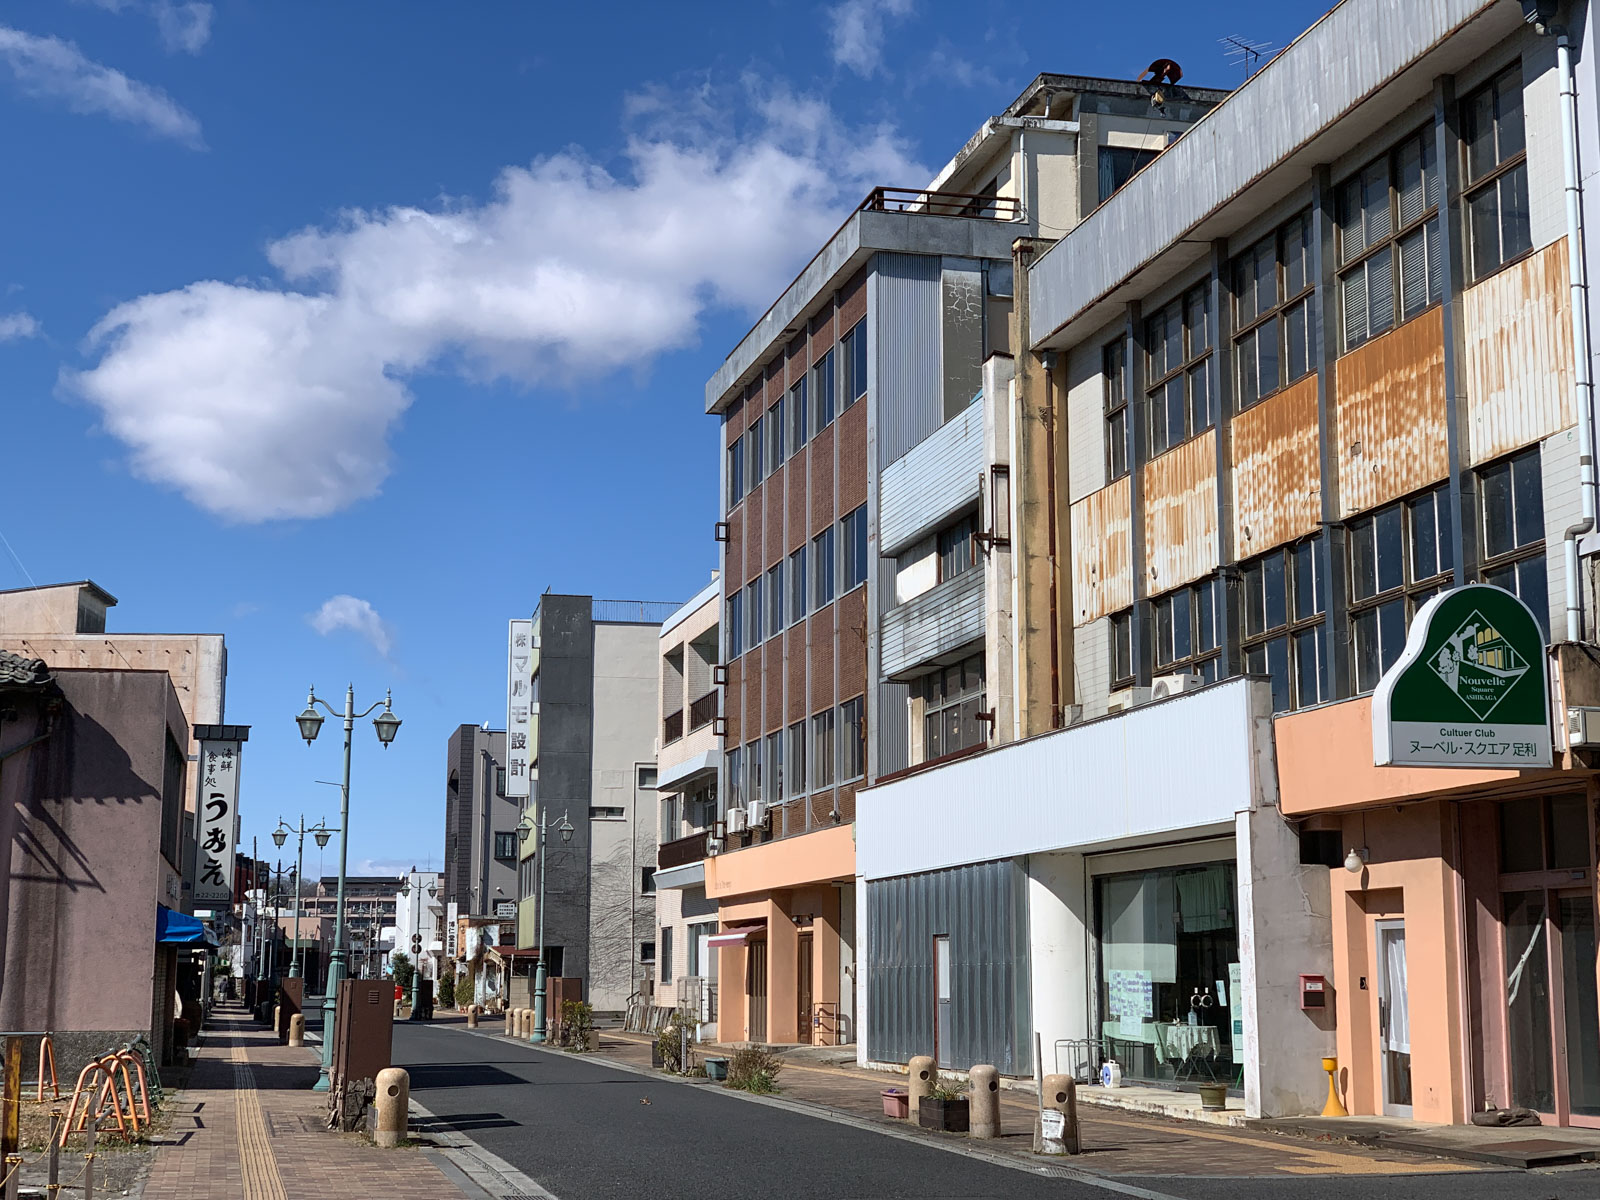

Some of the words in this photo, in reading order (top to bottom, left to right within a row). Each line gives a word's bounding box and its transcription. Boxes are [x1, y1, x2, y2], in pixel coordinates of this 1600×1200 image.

[1458, 675, 1506, 686] Nouvelle
[1439, 728, 1472, 737] Cultuer
[1474, 729, 1496, 738] Club
[204, 751, 218, 787] 食事処
[220, 747, 233, 772] 海鮮
[200, 792, 229, 887] うおえ
